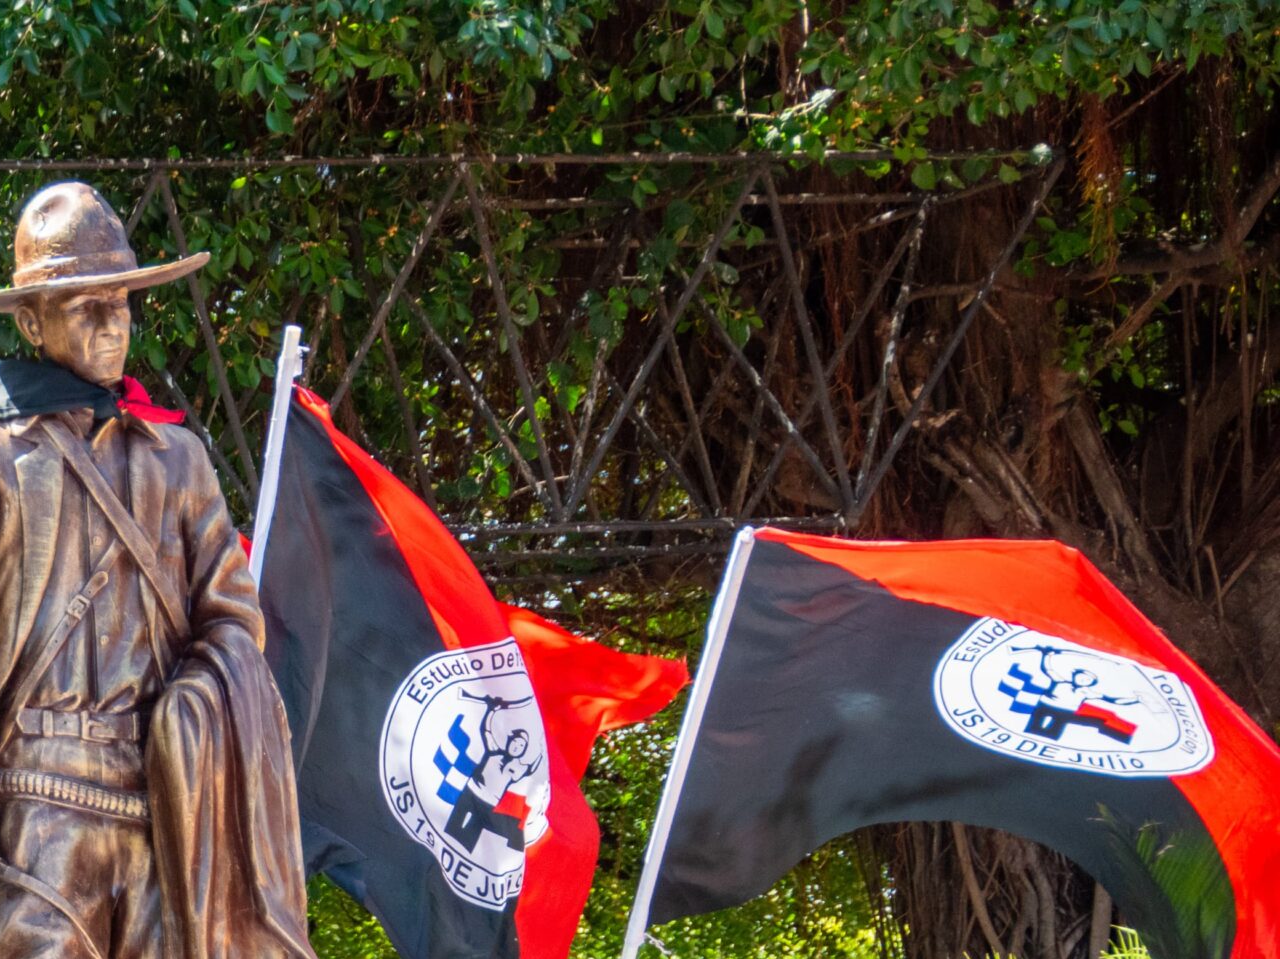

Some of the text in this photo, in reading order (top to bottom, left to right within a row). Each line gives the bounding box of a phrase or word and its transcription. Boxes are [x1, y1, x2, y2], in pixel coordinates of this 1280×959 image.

[954, 620, 1014, 662] Estudi
[953, 707, 1144, 770] JS 19 DE Julio
[1152, 674, 1198, 755] roduccion
[389, 776, 414, 814] JS
[415, 818, 436, 846] 19
[441, 849, 473, 888] DE
